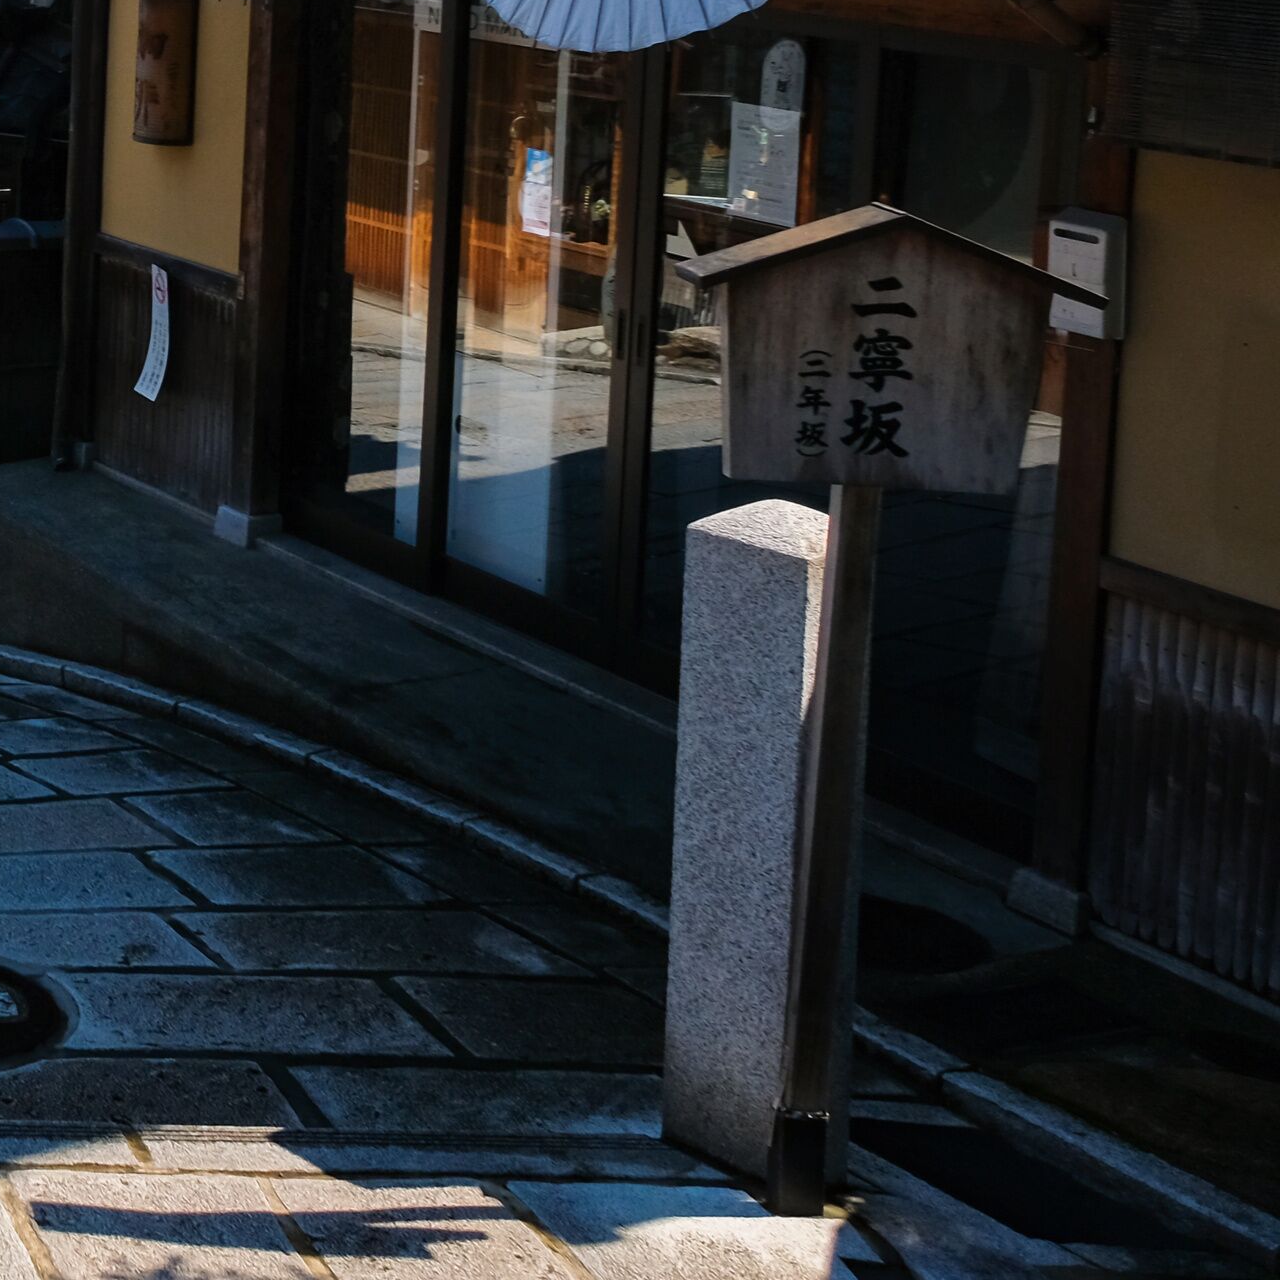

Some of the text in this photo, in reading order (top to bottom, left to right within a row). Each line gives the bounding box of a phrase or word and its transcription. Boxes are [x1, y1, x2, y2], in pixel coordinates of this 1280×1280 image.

[795, 350, 833, 458] （二年坂）
[841, 276, 917, 459] 二寧坂
